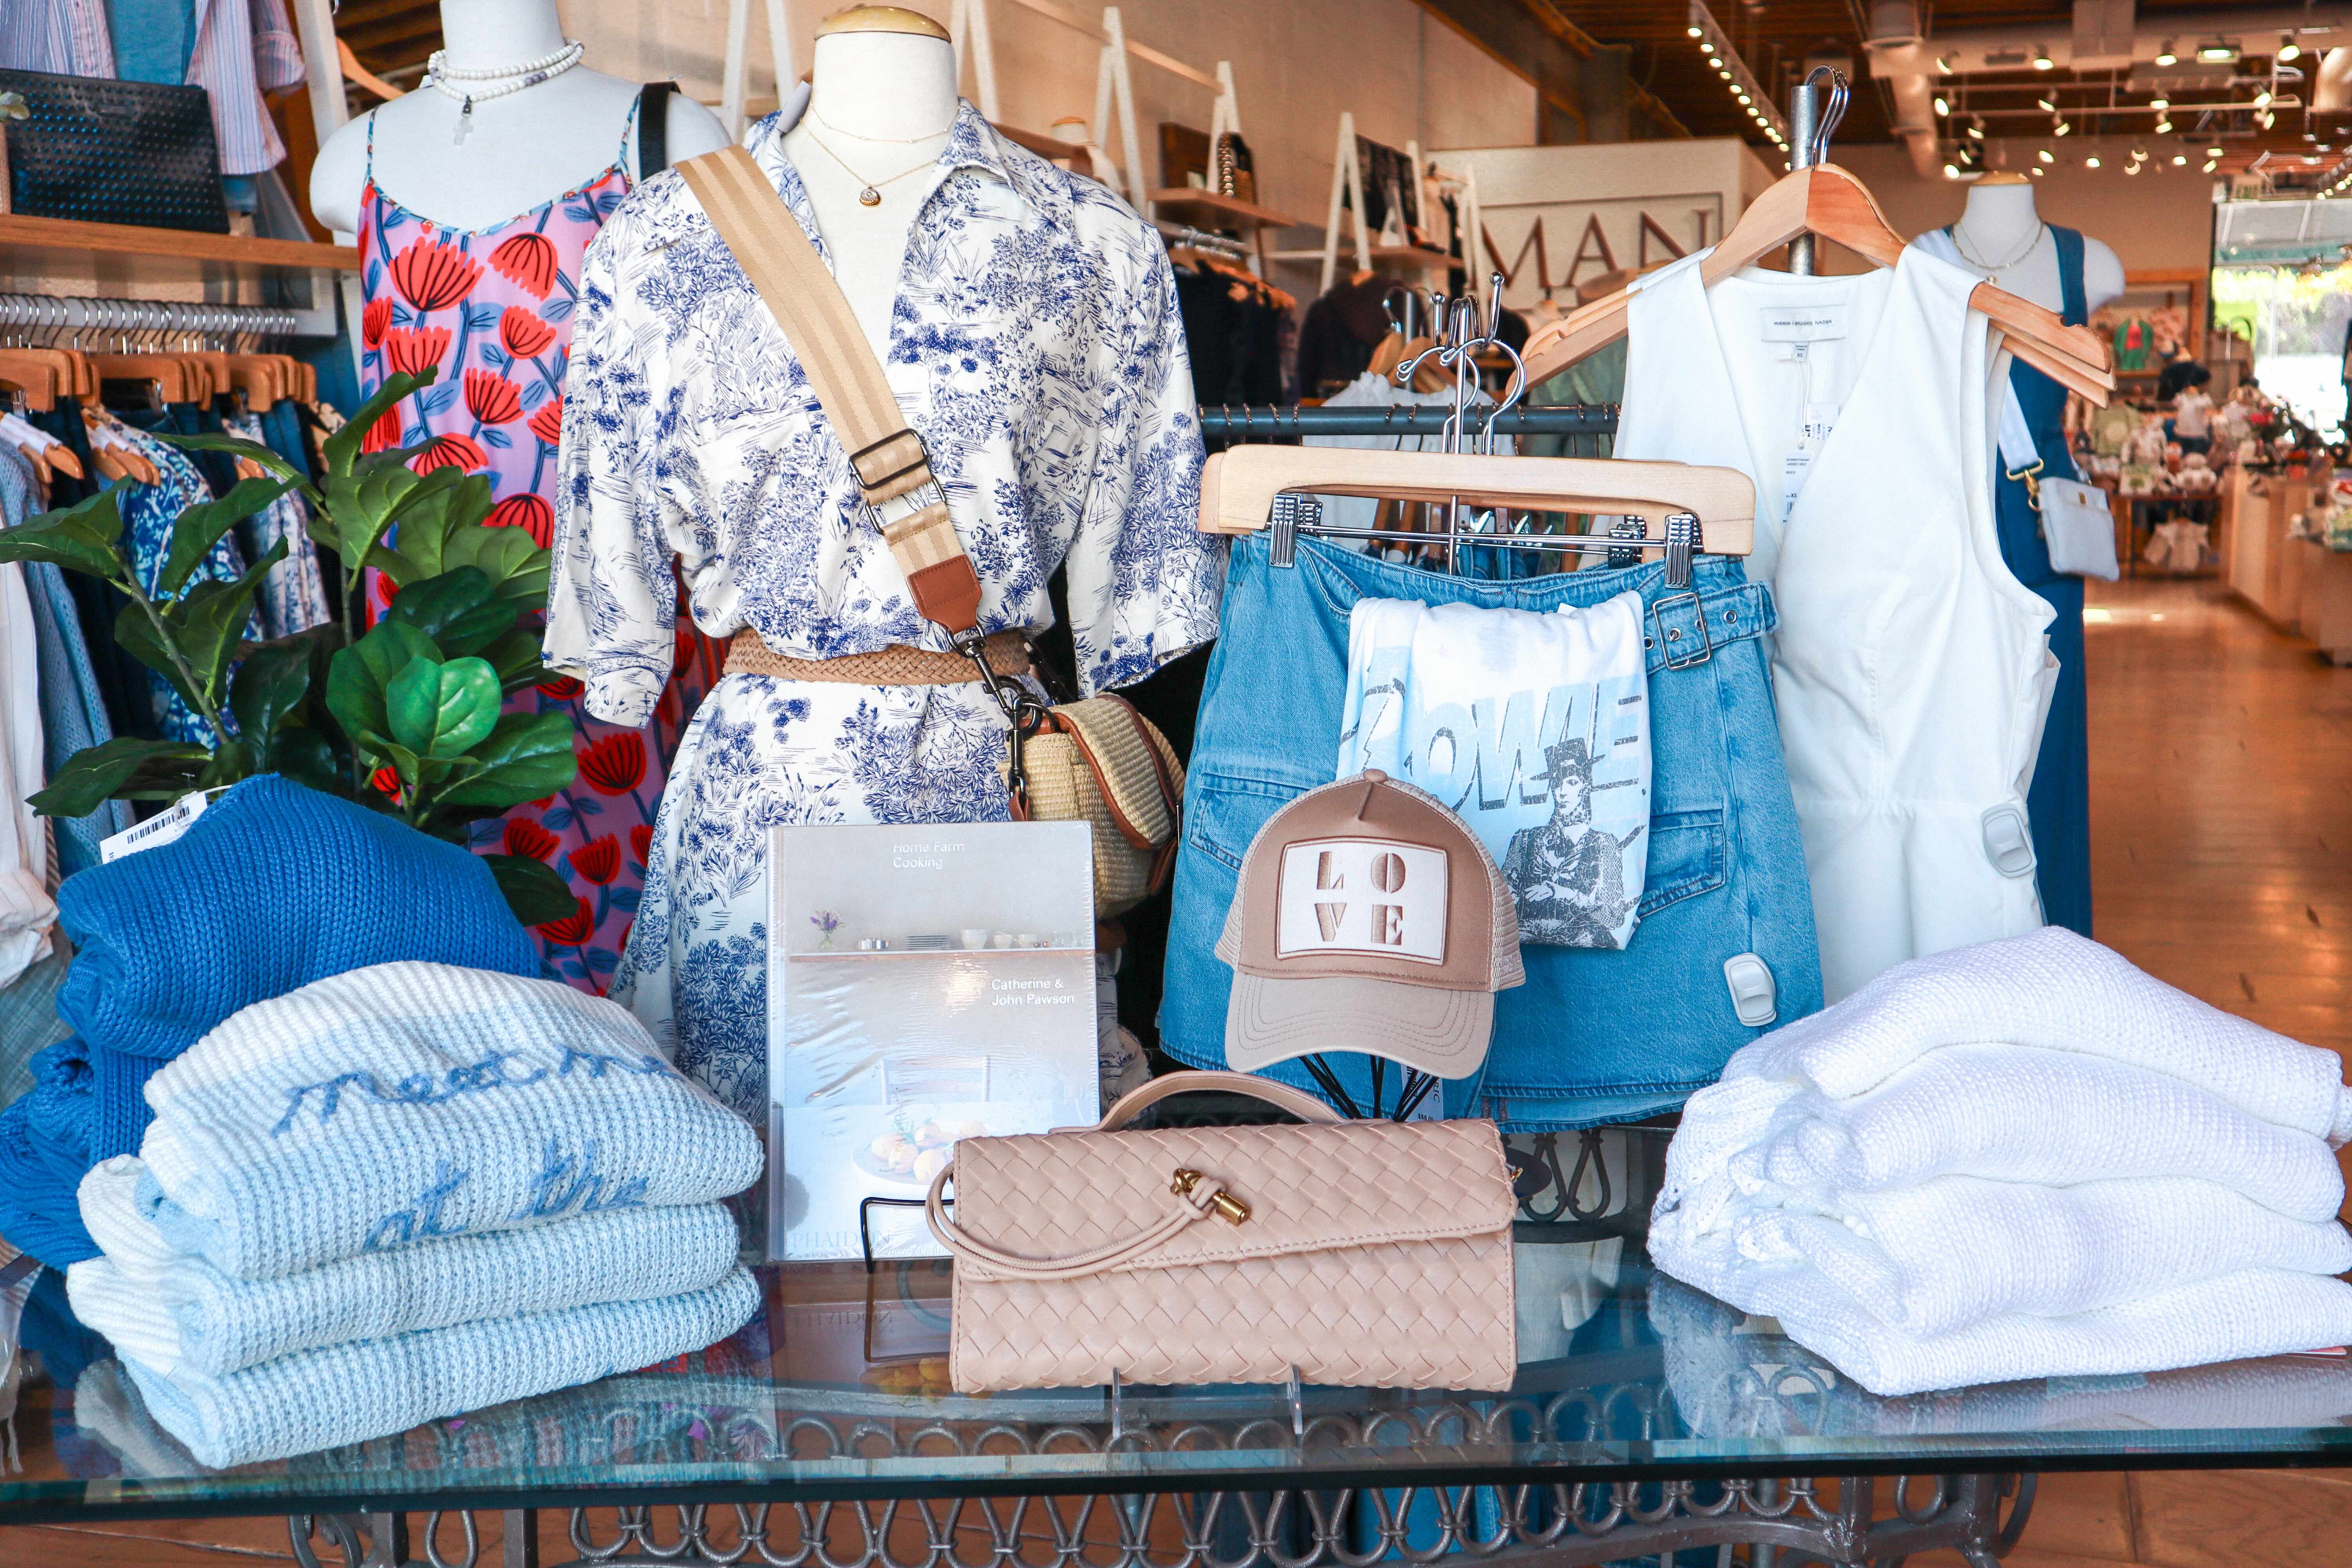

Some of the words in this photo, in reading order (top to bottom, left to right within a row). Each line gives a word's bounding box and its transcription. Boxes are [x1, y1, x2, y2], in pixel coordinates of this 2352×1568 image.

[893, 842, 929, 853] Home
[933, 840, 965, 852] Farm
[893, 857, 942, 870] Cooking
[991, 978, 1051, 991] Catherine
[1054, 978, 1064, 988] &
[991, 994, 1022, 1006] John
[1026, 993, 1074, 1005] Pawson
[505, 1137, 650, 1221] the
